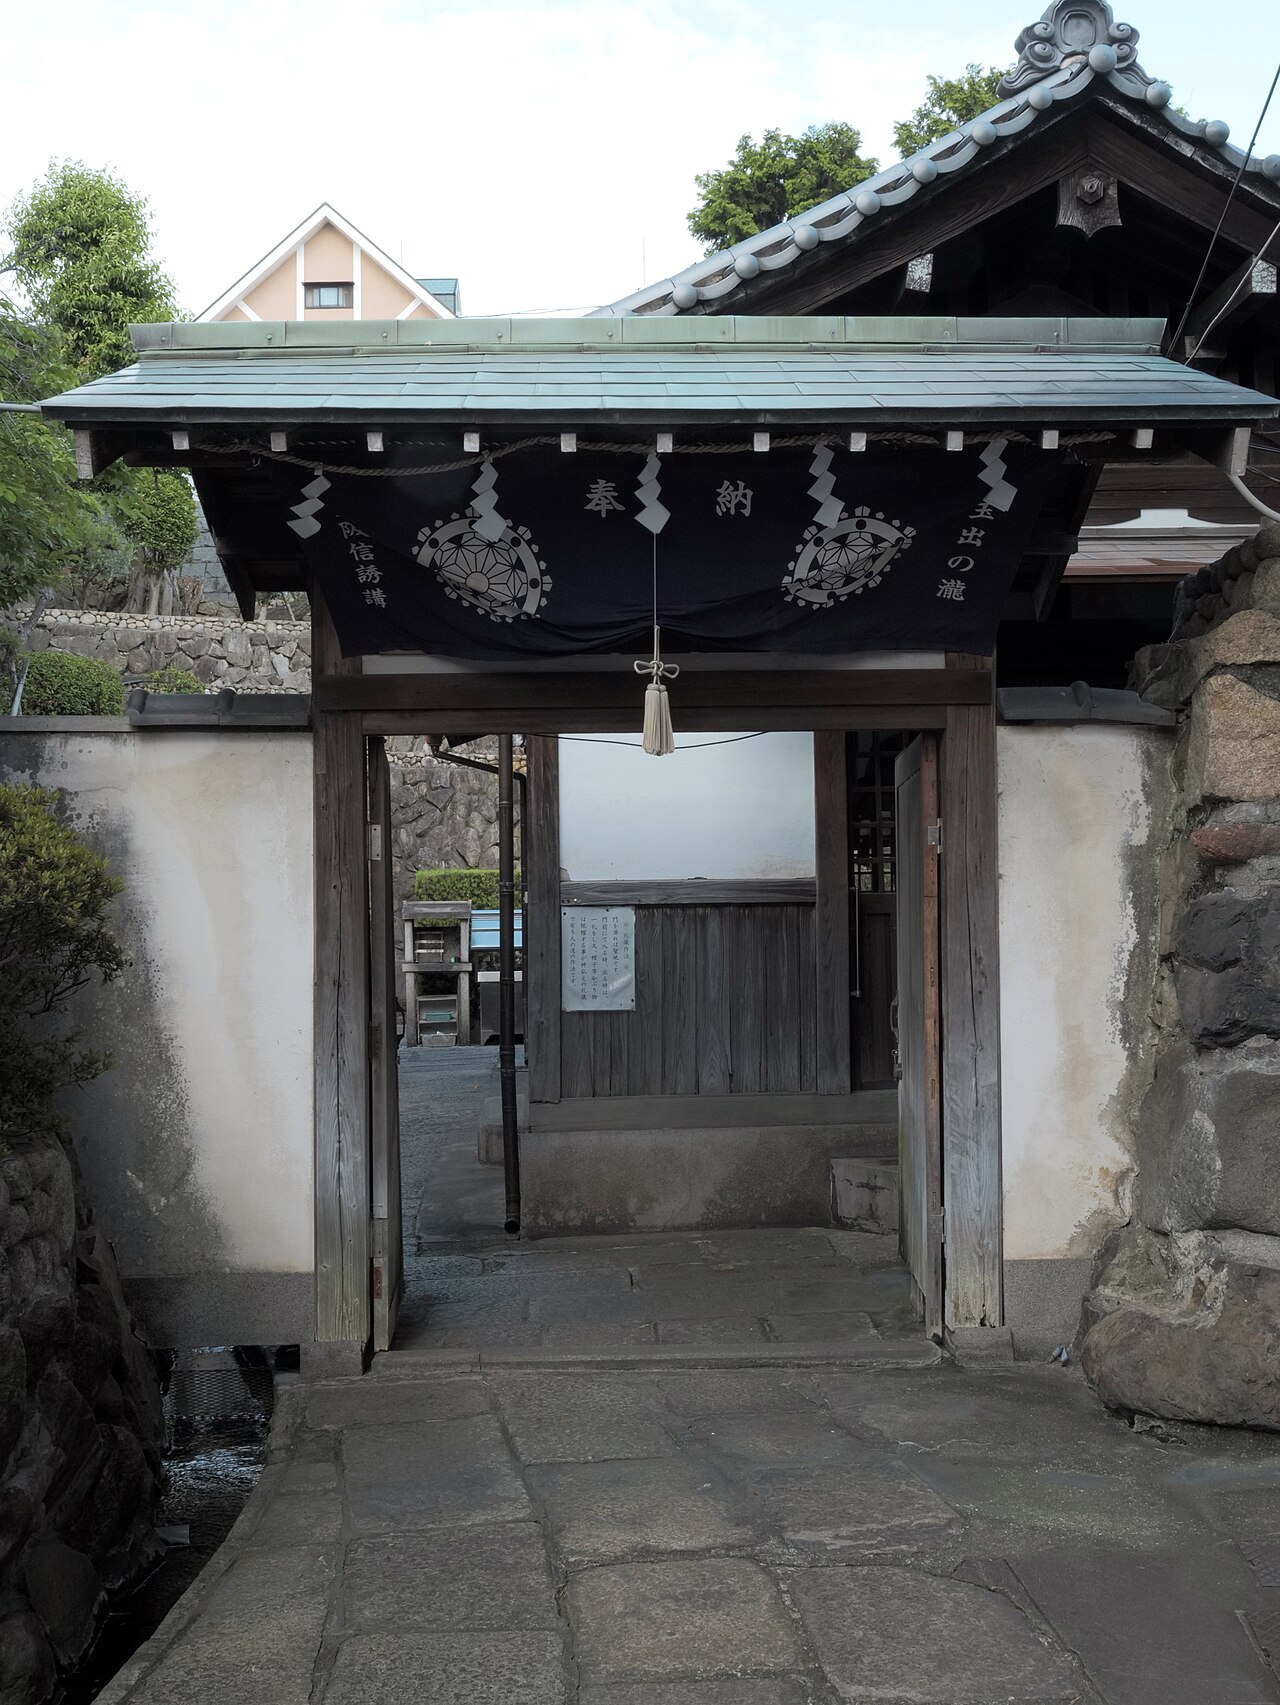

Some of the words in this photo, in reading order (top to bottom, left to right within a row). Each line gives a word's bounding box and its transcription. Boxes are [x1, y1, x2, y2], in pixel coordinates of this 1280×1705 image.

[336, 515, 387, 608] 阪信誘講
[936, 502, 995, 601] 玉出の瀧
